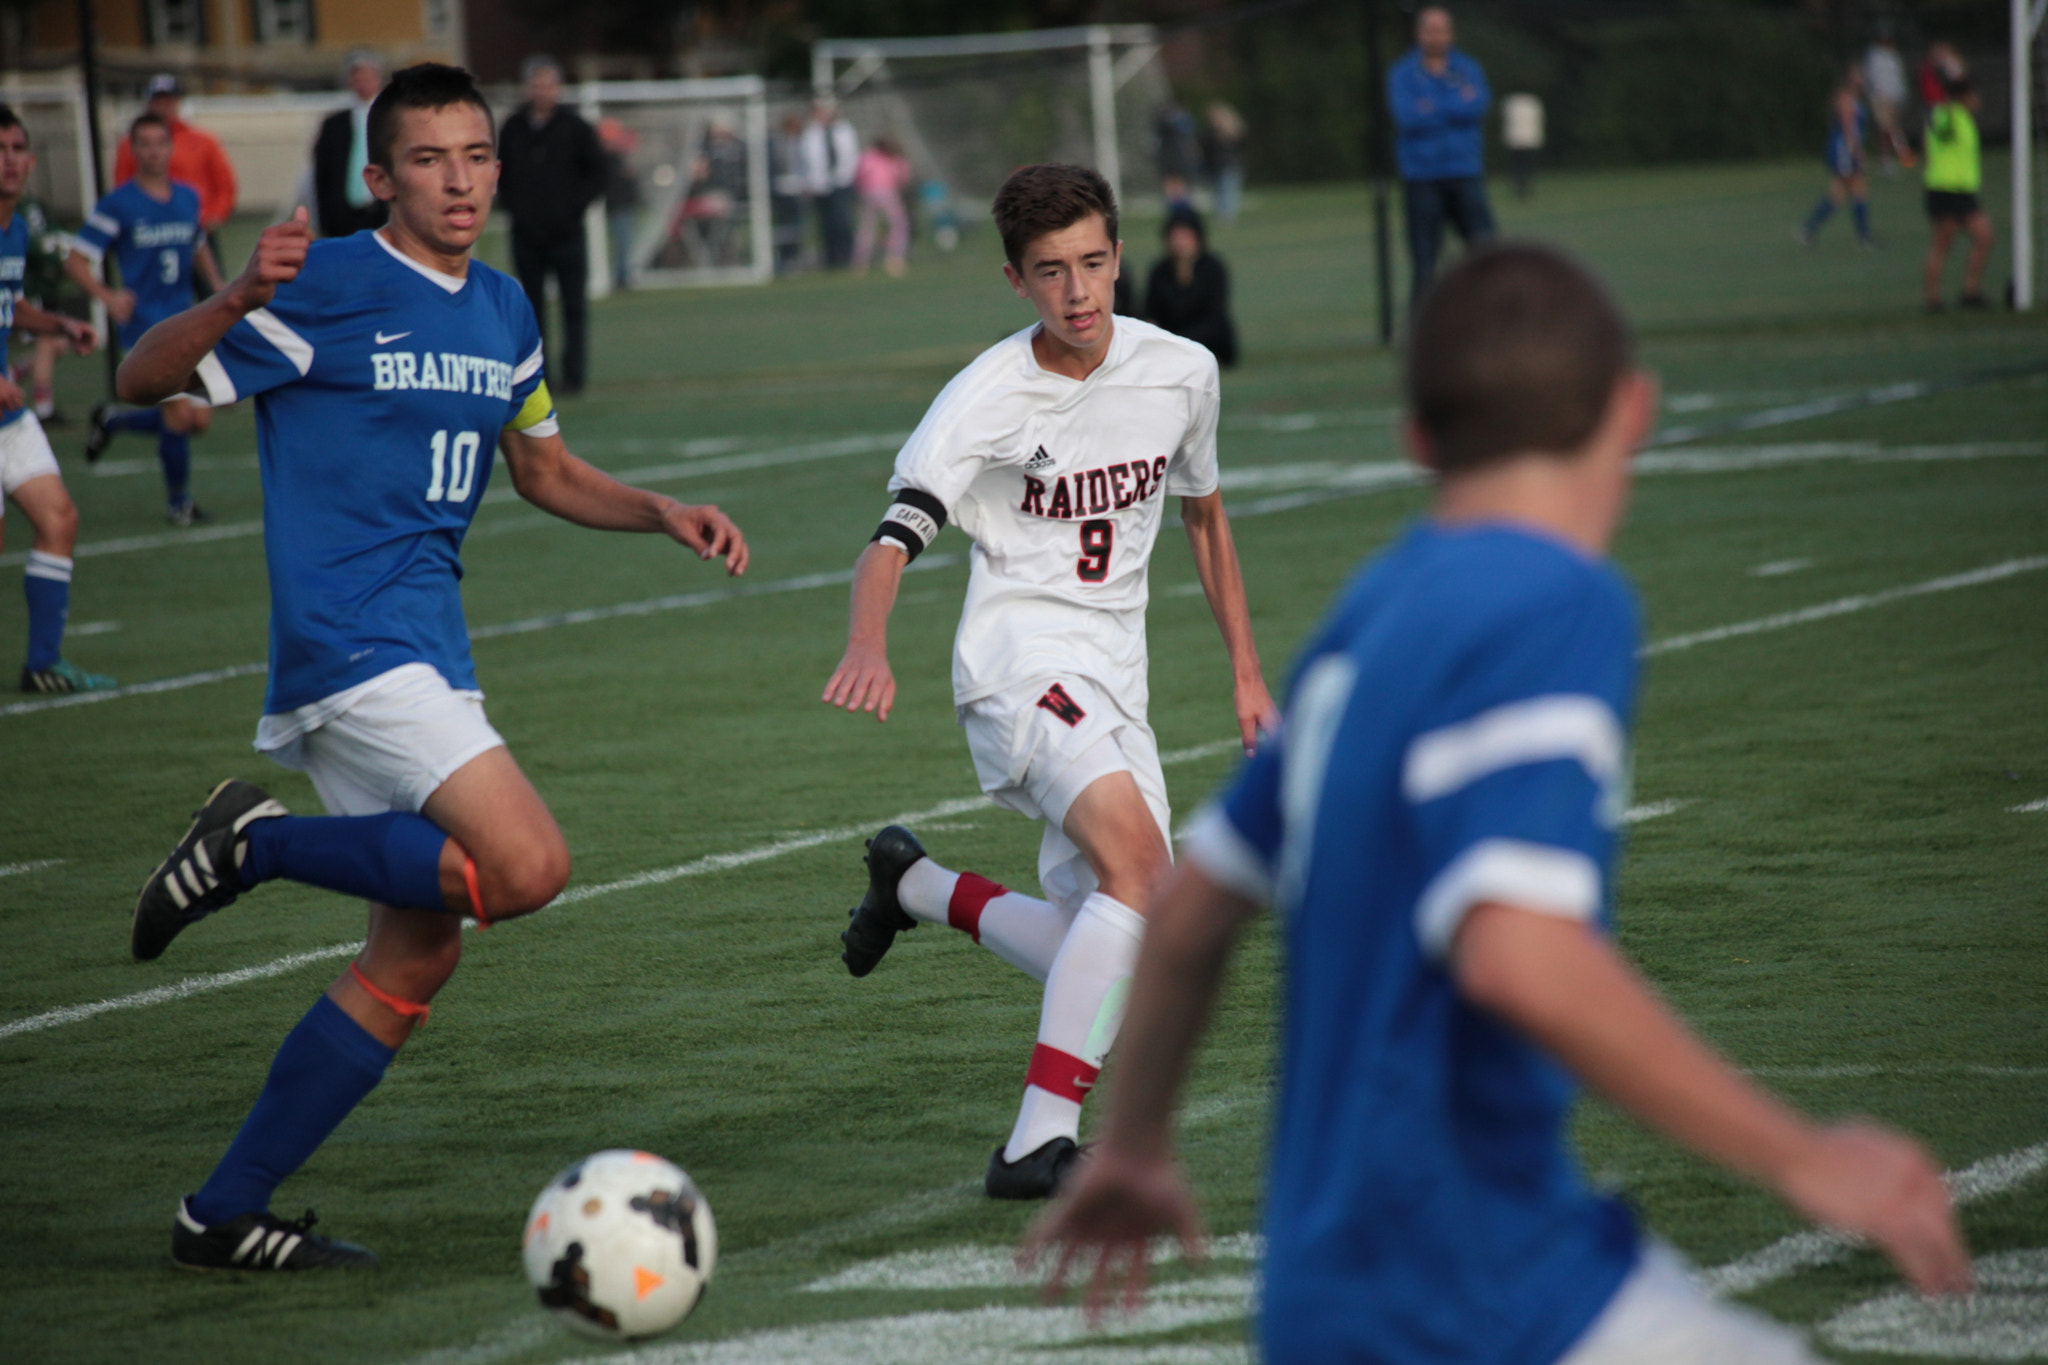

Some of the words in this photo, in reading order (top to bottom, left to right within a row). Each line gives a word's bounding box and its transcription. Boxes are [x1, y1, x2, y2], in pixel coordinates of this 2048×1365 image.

[159, 248, 180, 285] 3
[426, 429, 480, 503] 10
[1021, 455, 1166, 519] RAIDERS
[1077, 519, 1113, 583] 9
[1036, 682, 1087, 729] W
